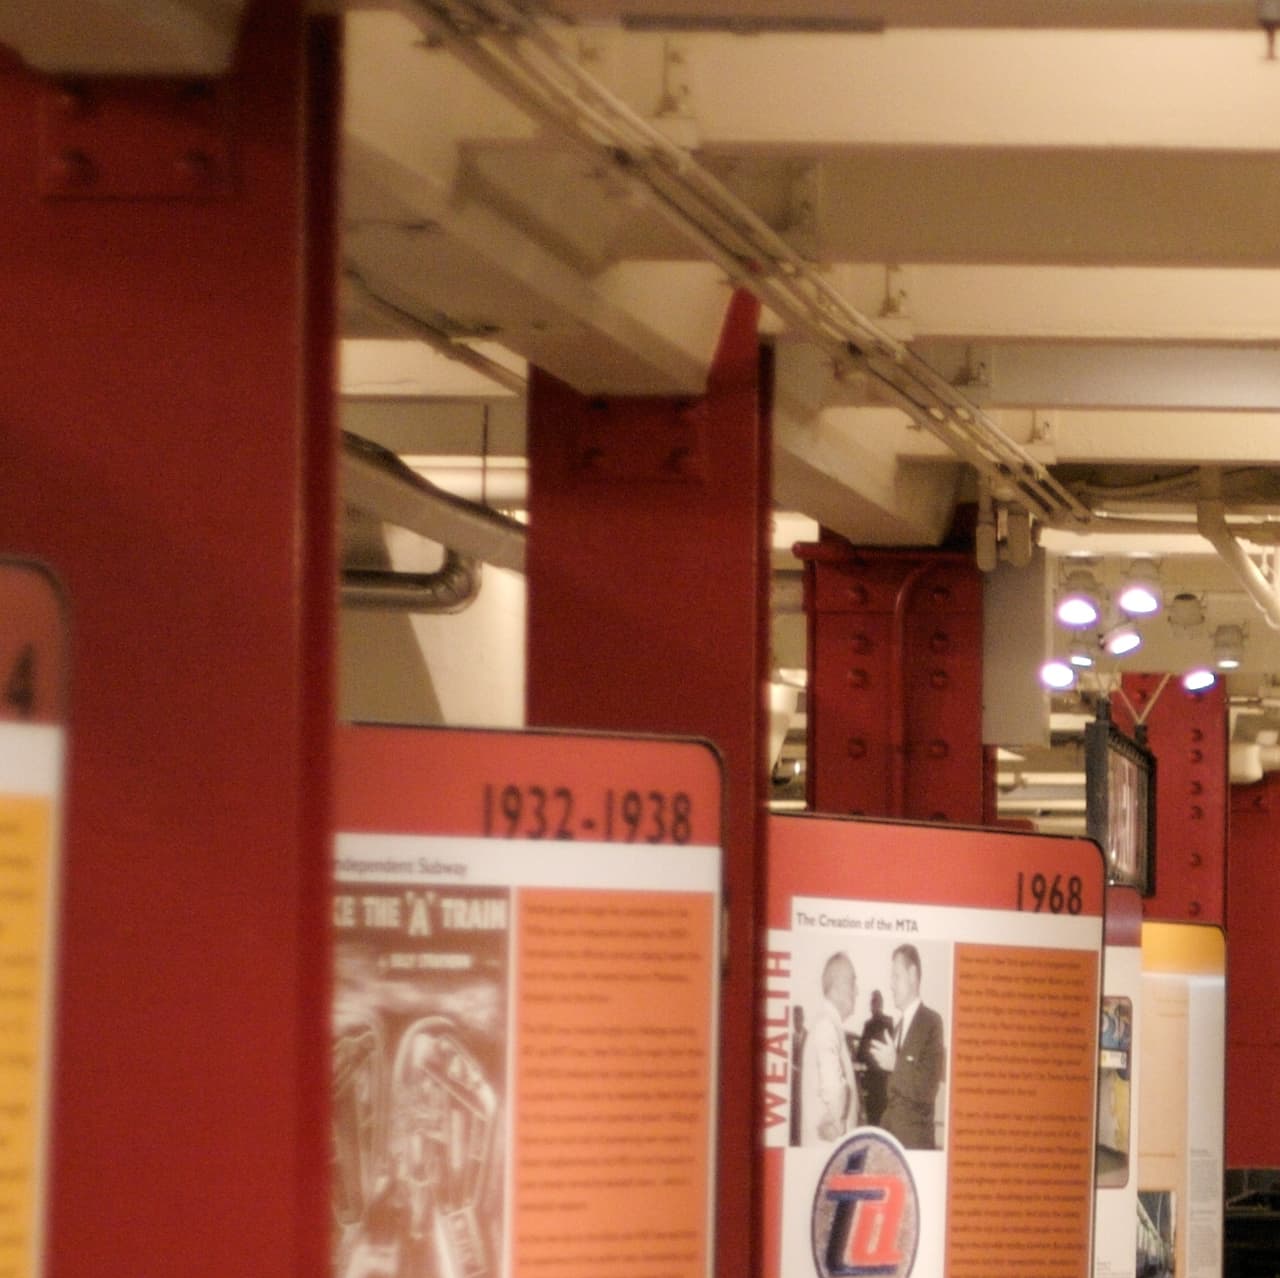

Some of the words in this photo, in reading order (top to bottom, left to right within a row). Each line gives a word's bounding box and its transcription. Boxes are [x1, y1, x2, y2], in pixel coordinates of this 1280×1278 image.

[482, 784, 693, 845] 1932-1938
[363, 896, 400, 928] THE
[441, 898, 507, 930] TRAIN
[1016, 872, 1084, 915] 1968
[796, 912, 816, 926] The
[818, 914, 862, 928] Creation
[864, 917, 876, 930] of
[877, 918, 892, 931] the
[895, 919, 919, 932] MTA
[765, 951, 791, 1129] WEALTH
